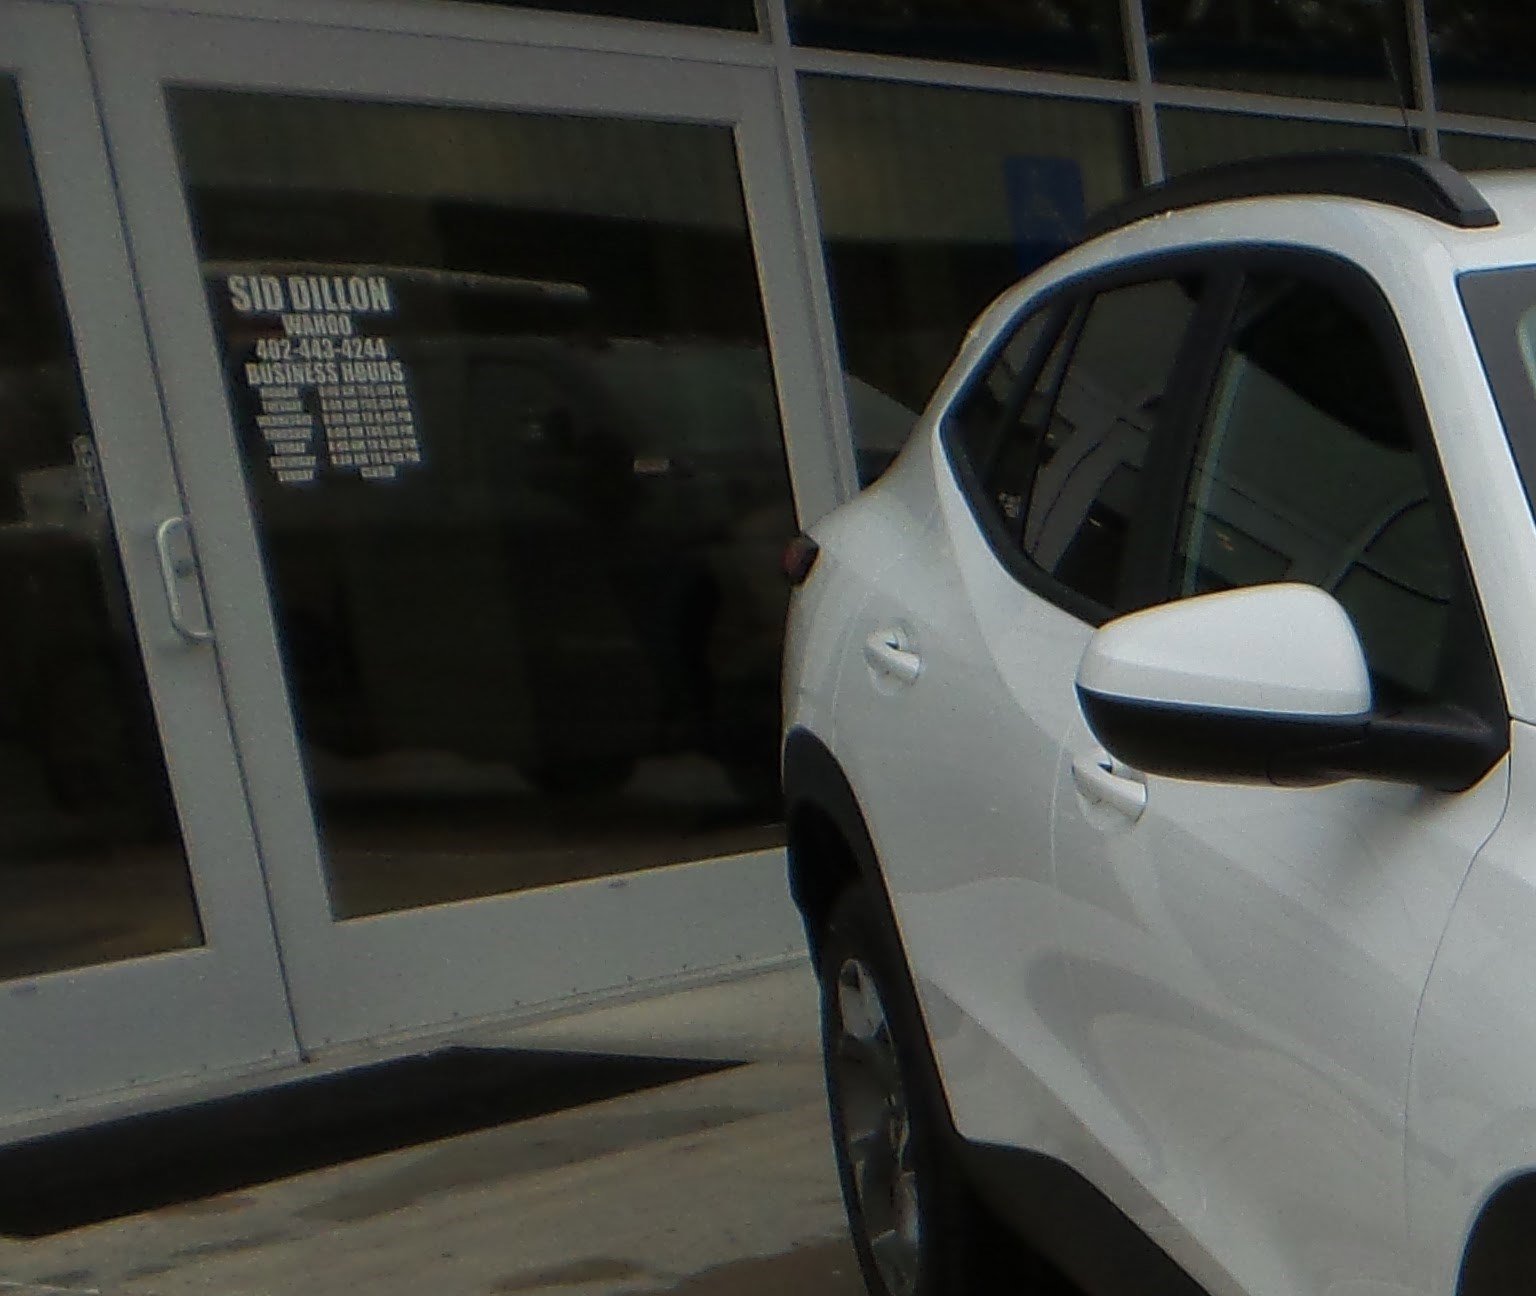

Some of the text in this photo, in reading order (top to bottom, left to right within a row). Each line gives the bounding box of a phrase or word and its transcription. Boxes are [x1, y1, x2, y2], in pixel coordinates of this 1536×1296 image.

[227, 275, 391, 312] SID DILLON
[281, 313, 352, 336] WAHOO
[245, 361, 405, 385] BUSINESS HOURS
